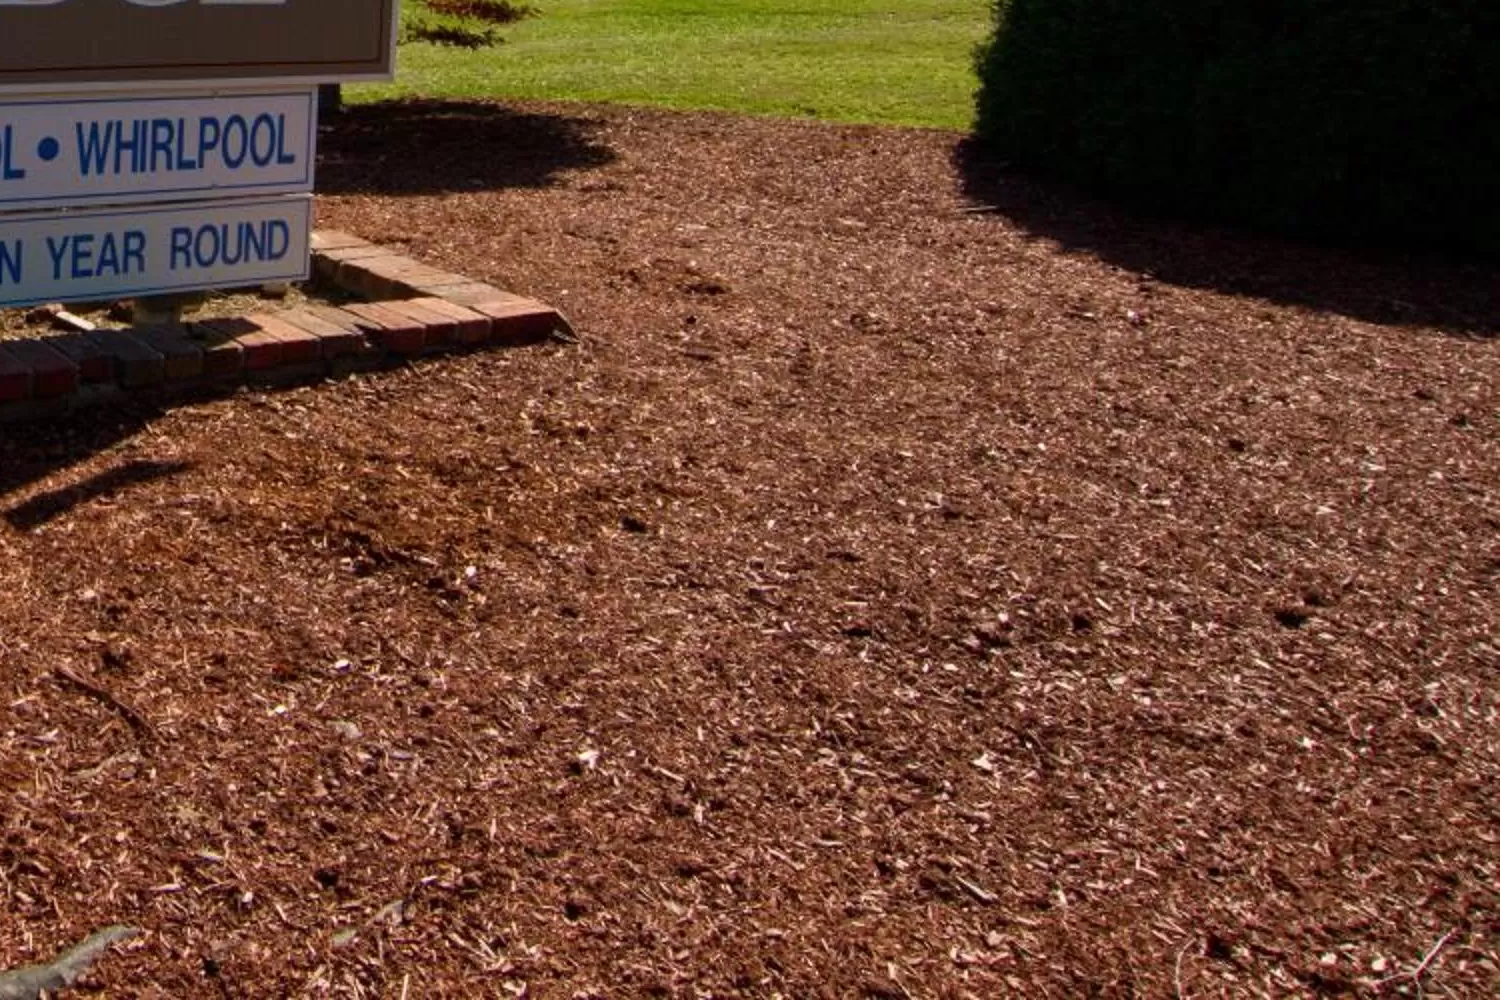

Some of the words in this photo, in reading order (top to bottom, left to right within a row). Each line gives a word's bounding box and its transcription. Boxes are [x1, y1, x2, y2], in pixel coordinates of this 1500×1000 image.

[75, 113, 295, 176] WHIRLPOOL
[45, 231, 145, 281] YEAR
[169, 220, 290, 270] ROUND
